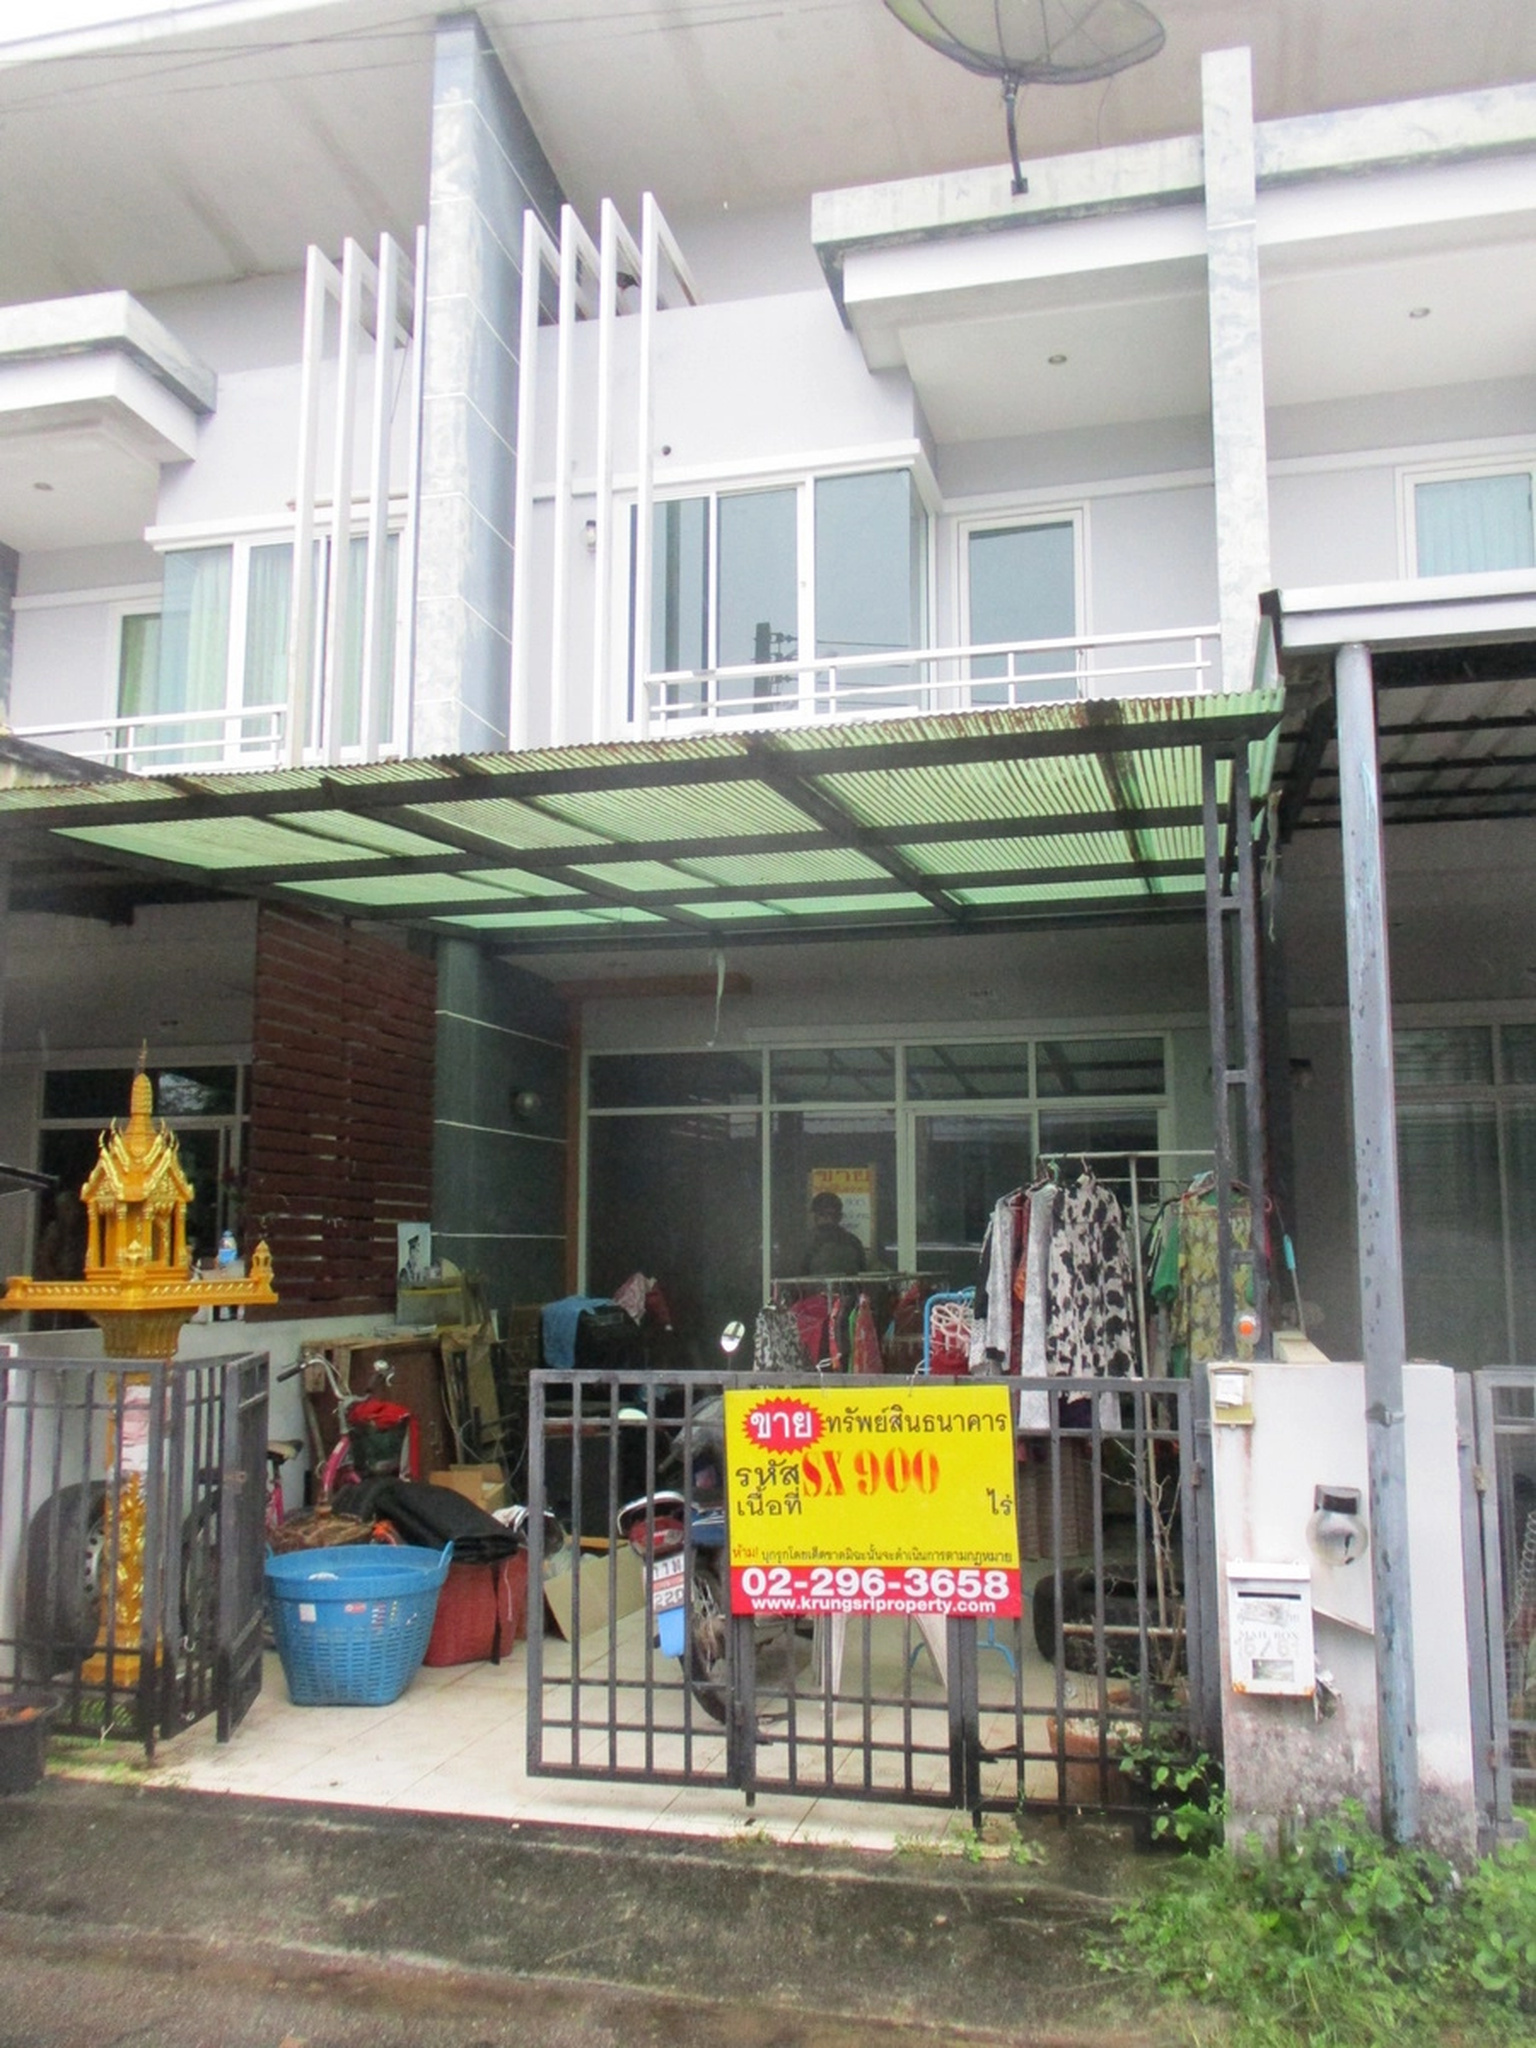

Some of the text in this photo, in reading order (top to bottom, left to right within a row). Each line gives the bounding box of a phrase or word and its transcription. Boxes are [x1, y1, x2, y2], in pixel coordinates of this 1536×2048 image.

[750, 1404, 1007, 1439] ขาย ทรัพย์สินธนาคาร
[735, 1459, 800, 1487] รหัส
[853, 1447, 940, 1496] 900
[737, 1486, 1013, 1516] เนื้อที่ ไร่
[741, 1566, 1010, 1600] 02-296-3658
[751, 1594, 997, 1616] www.krungsriproperty.com
